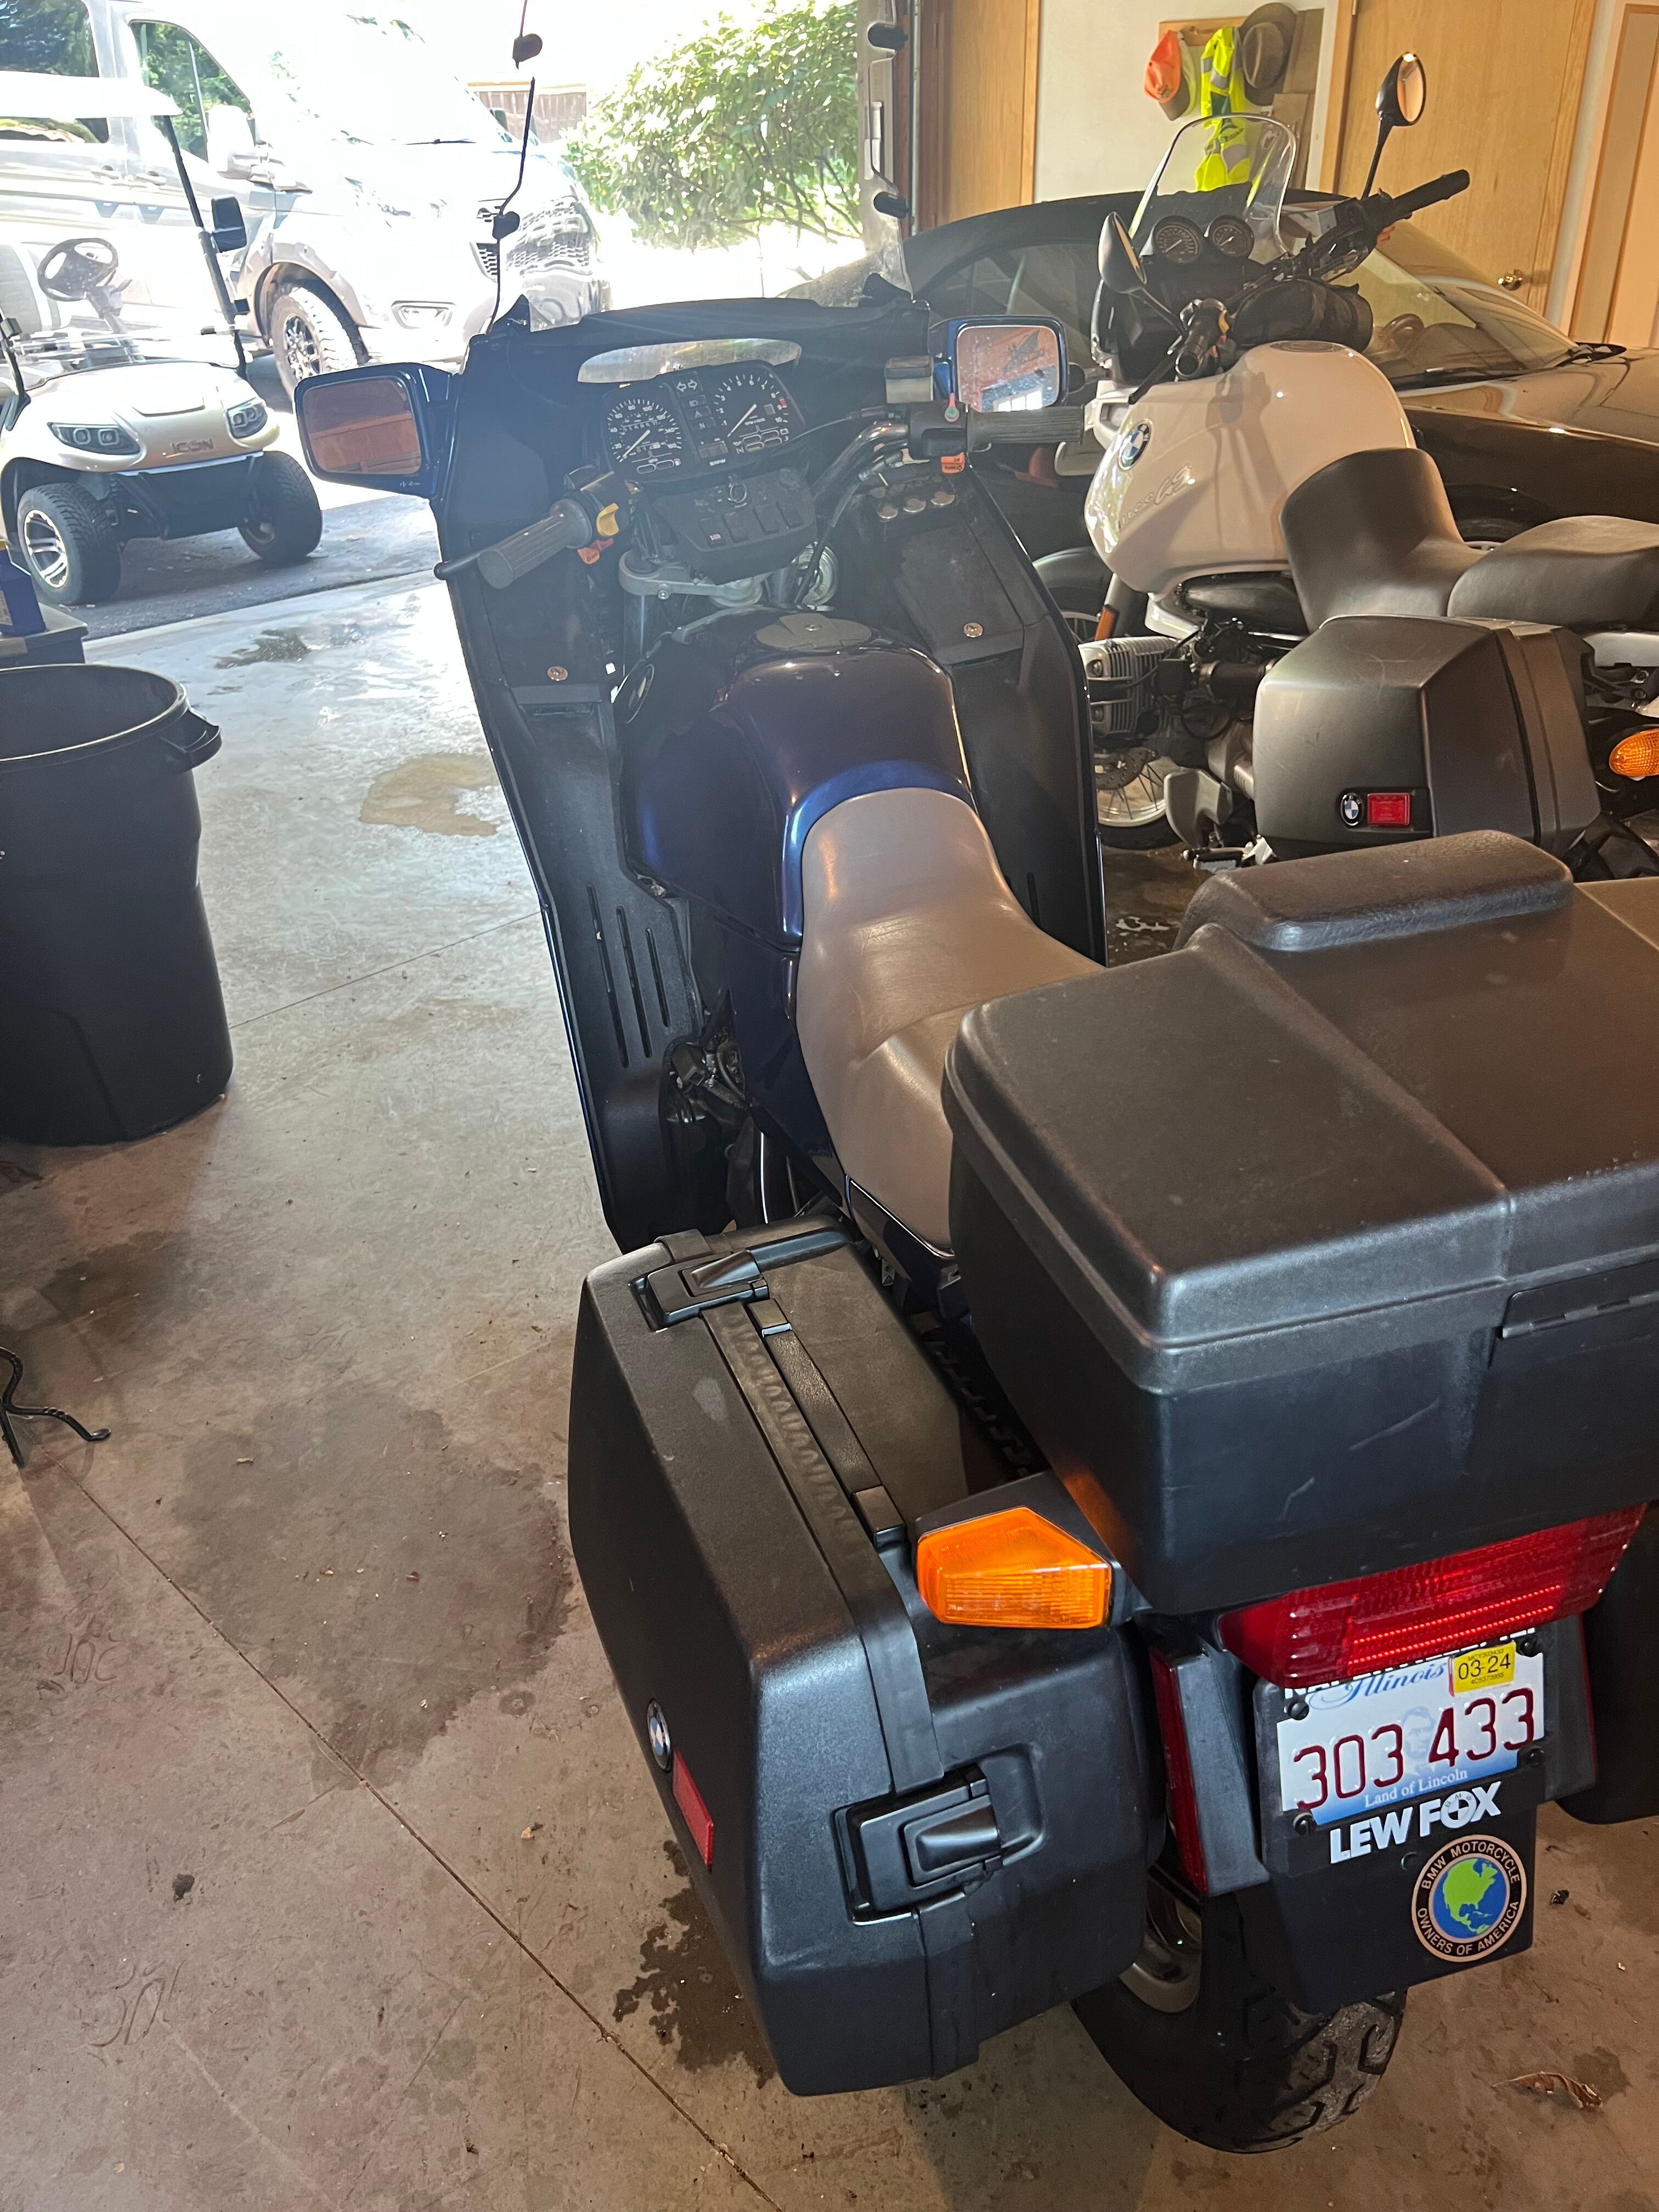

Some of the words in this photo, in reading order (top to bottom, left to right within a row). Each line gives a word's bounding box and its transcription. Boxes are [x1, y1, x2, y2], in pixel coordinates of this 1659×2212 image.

[172, 439, 213, 453] ICON
[1310, 1662, 1447, 1710] Illinois
[1293, 1723, 1404, 1809] 303
[1428, 1688, 1535, 1768] 433
[1364, 1791, 1398, 1808] Land
[1402, 1781, 1417, 1796] of
[1418, 1768, 1468, 1791] Lincoln
[1330, 1807, 1413, 1864] LEW
[1419, 1781, 1502, 1838] FOX
[1421, 1855, 1446, 1889] BMW
[1450, 1841, 1520, 1884] MOTORCYCLE
[1417, 1908, 1453, 1954] OWNERS
[1456, 1944, 1473, 1955] OF
[1477, 1901, 1519, 1951] AMERICA
